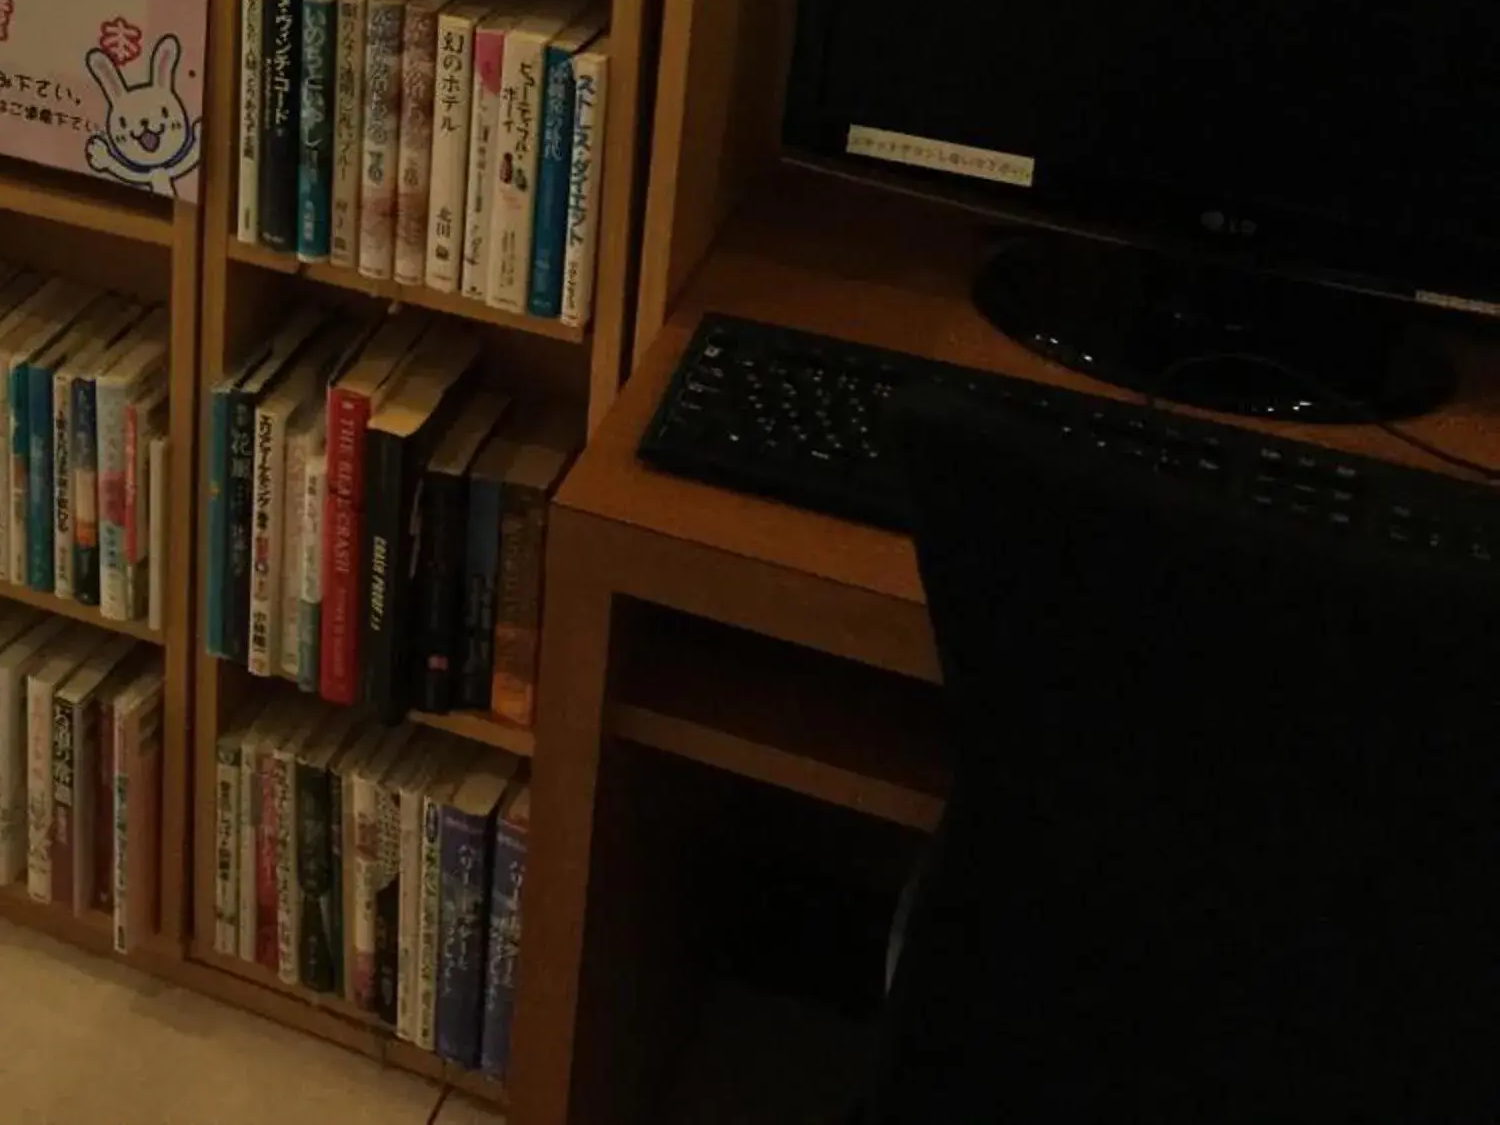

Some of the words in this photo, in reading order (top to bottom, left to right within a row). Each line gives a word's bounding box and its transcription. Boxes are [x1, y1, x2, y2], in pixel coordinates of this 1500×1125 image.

[440, 29, 465, 133] 幻のホテル
[569, 73, 596, 247] ストレス・ダイエット
[333, 512, 352, 574] CRASH
